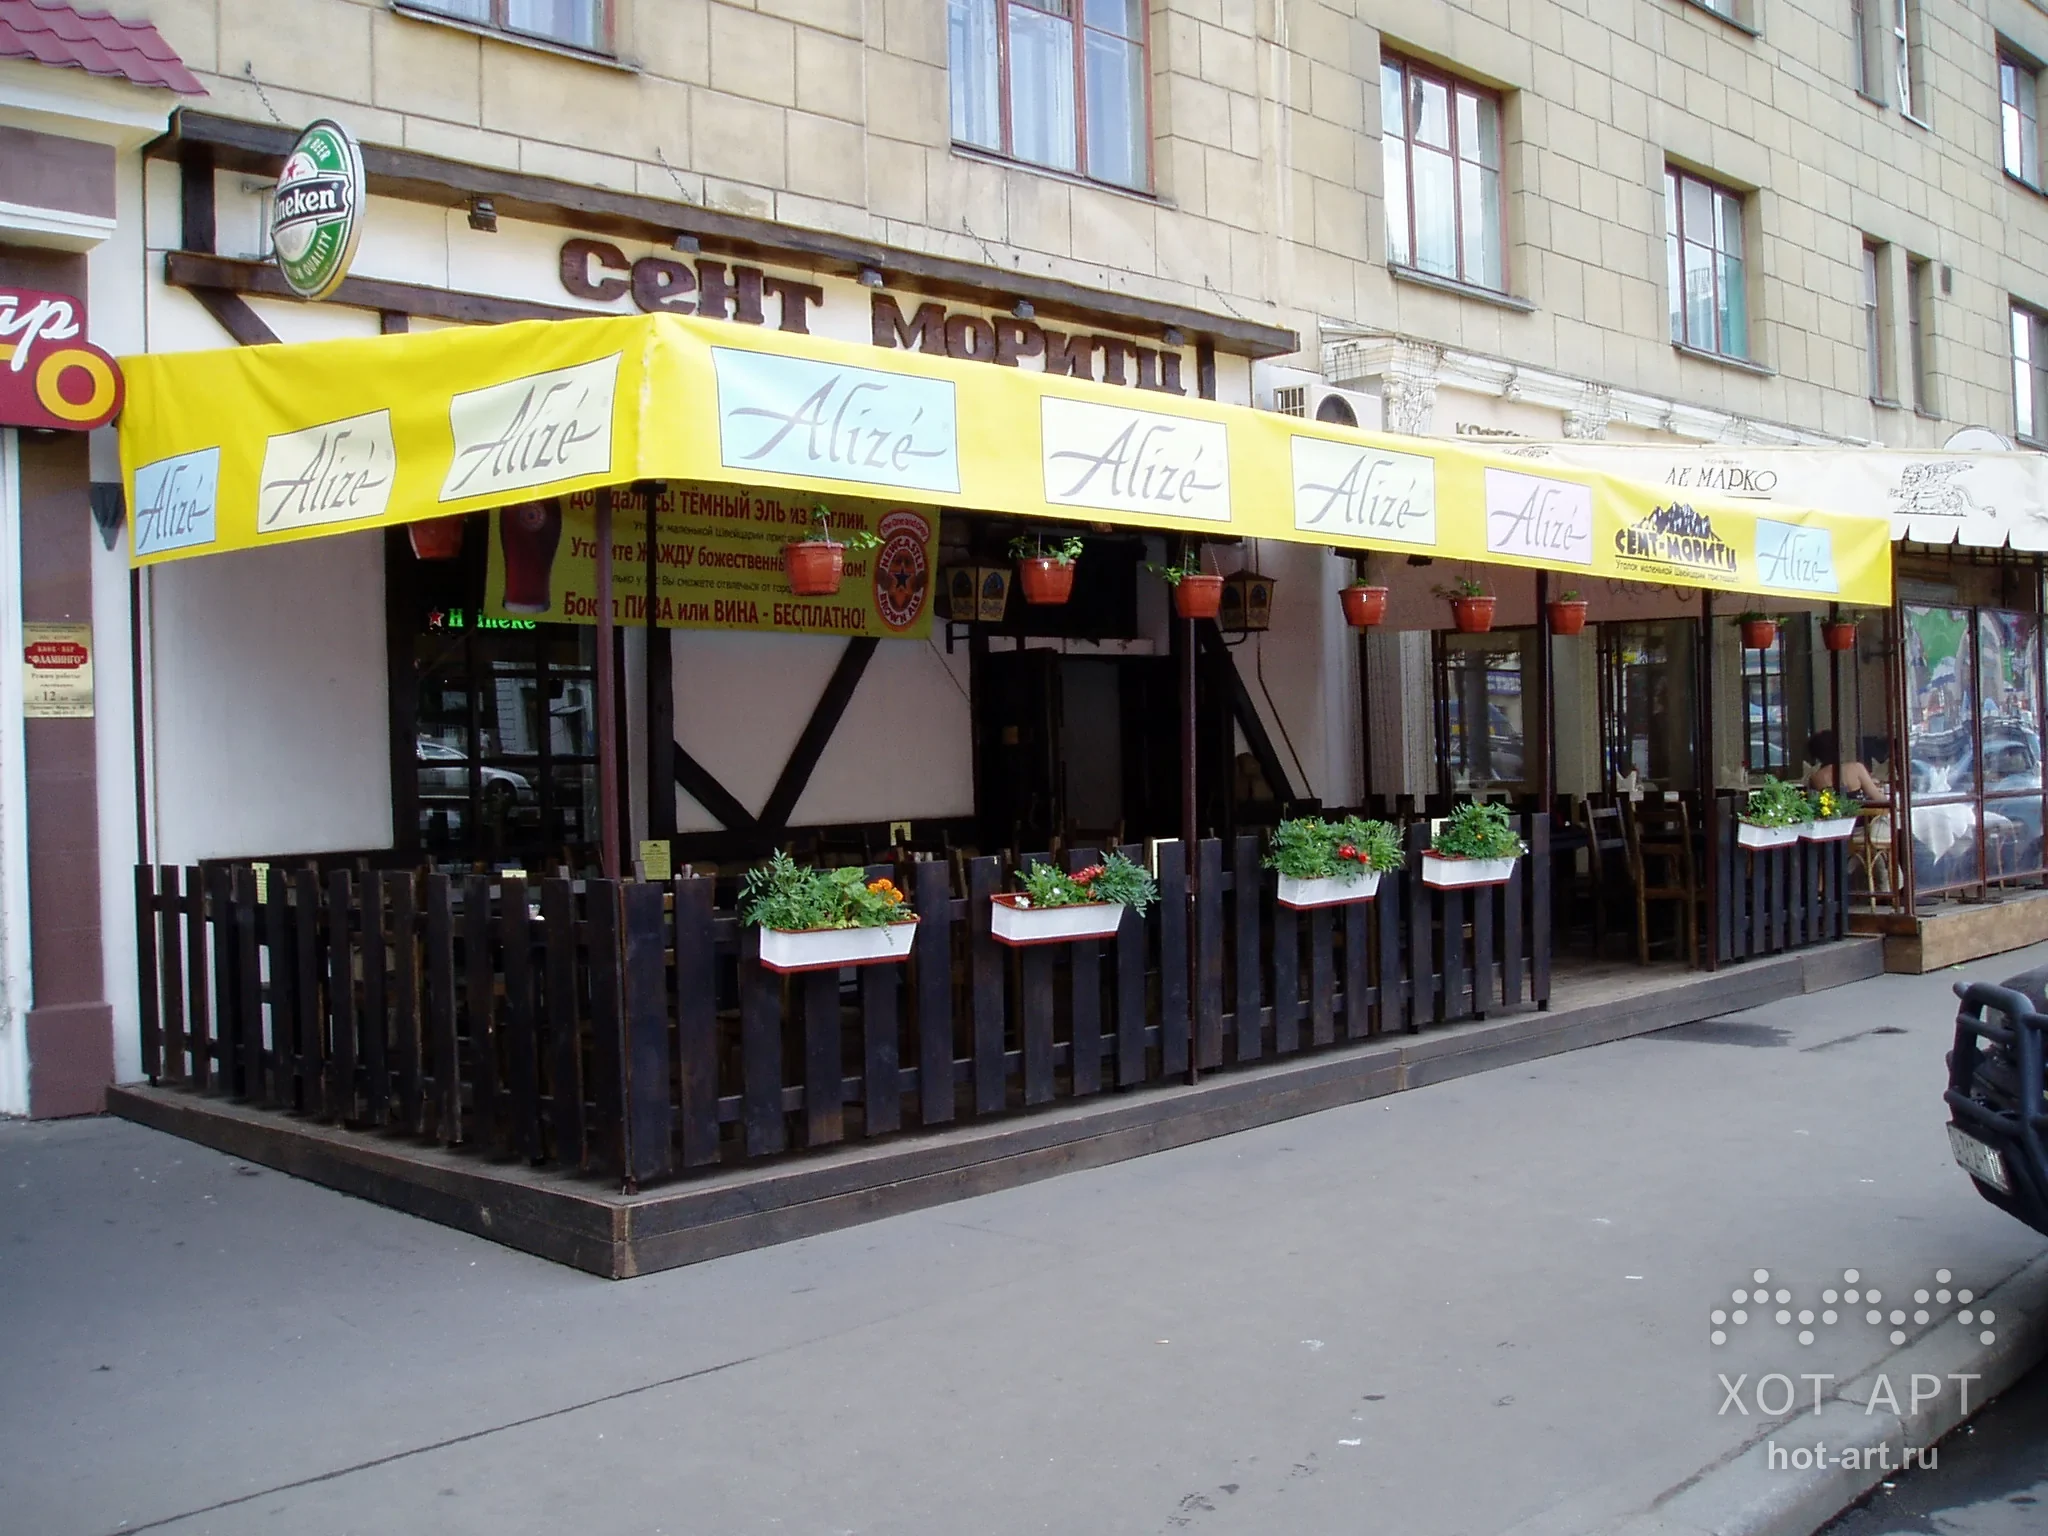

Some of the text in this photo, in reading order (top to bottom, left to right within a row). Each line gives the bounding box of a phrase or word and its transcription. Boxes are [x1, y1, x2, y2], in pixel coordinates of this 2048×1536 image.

[310, 138, 331, 162] BEER
[302, 230, 333, 277] QUALITY
[451, 381, 600, 492] Alizé
[730, 374, 947, 469] Alizé
[260, 431, 387, 525] Alizé
[1050, 419, 1222, 503] Alizé
[1696, 467, 1777, 491] МАРКО
[137, 464, 212, 549] Alizé
[570, 489, 675, 511] Додалсь!
[680, 486, 750, 519] ТЁМНЫЙ
[755, 499, 786, 523] ЭЛЬ
[790, 507, 807, 525] из
[1300, 455, 1429, 528] Alizé
[1490, 483, 1588, 551] Alizé
[571, 536, 633, 562] Утоите
[881, 538, 924, 569] NEWCASTLE
[1615, 528, 1737, 572] СЕНТ-МОРИТЦ
[1757, 535, 1830, 587] Alizé
[564, 591, 619, 618] Бокл
[678, 603, 709, 621] или
[714, 600, 759, 623] ВИНА
[773, 603, 866, 629] БЕСПЛАТНО!
[880, 593, 921, 623] BROWN ALE
